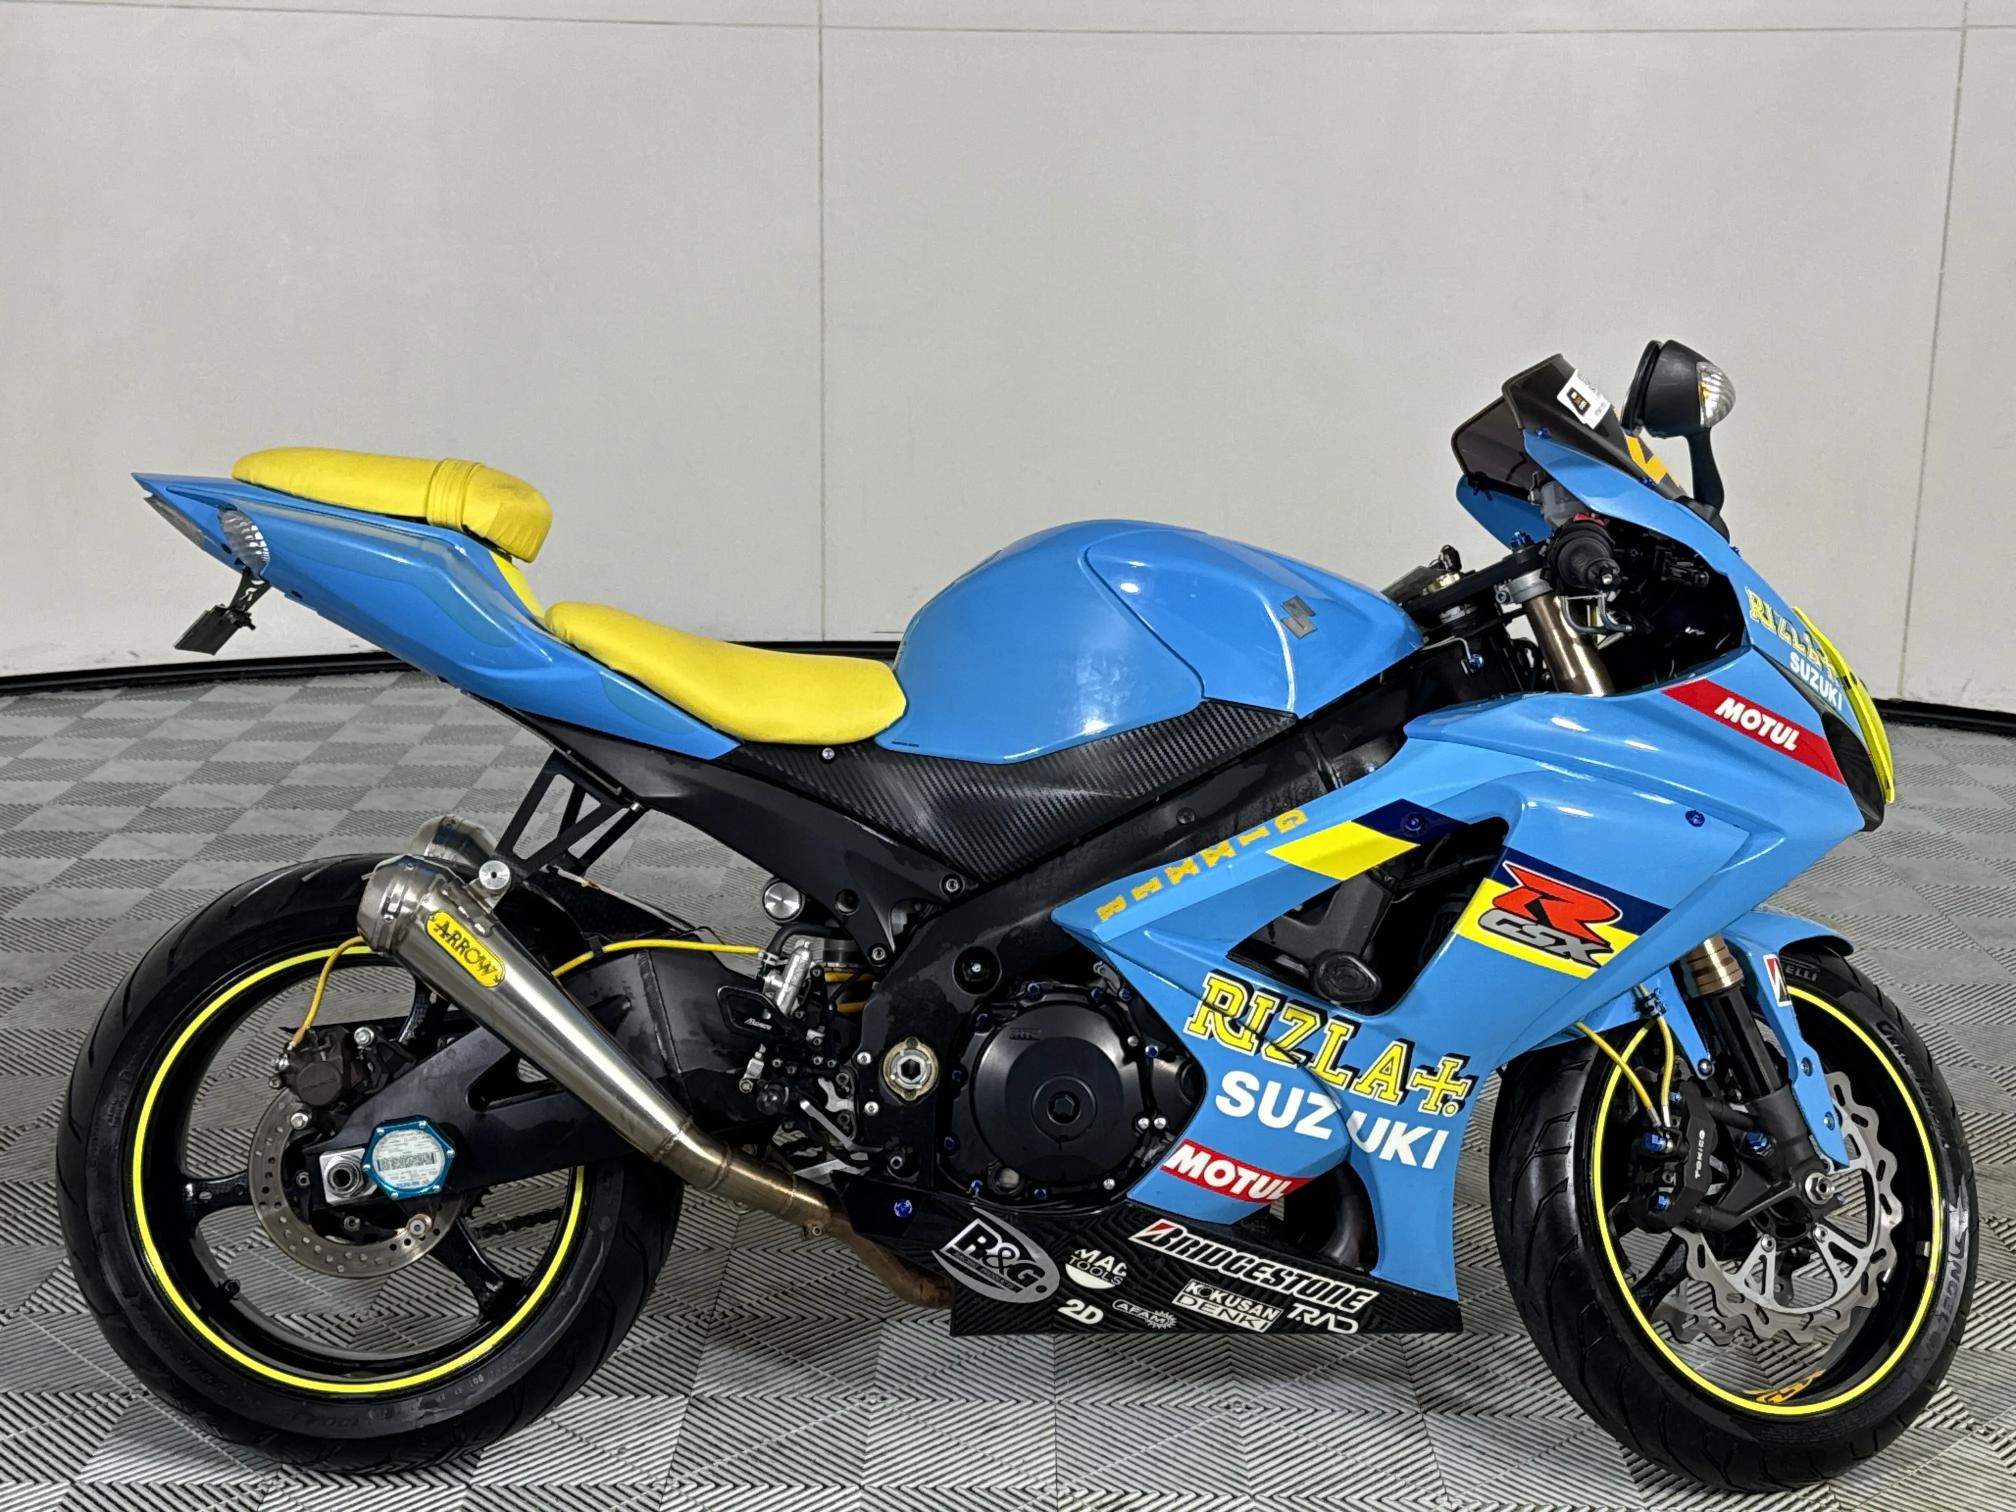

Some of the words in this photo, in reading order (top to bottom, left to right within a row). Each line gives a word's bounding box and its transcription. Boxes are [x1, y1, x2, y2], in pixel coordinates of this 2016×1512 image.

[1789, 651, 1843, 711] SUZUKI
[1714, 697, 1801, 752] MOTUL
[433, 920, 497, 977] ARROW
[1478, 907, 1615, 968] GSX
[1785, 963, 1819, 982] ELLI
[1215, 1071, 1449, 1169] SUZUKI
[1164, 1144, 1292, 1200] MOTUL
[1694, 1129, 1706, 1179] TOKICO
[944, 1220, 1046, 1288] R&G
[1069, 1255, 1124, 1286] TOOLS
[1074, 1248, 1128, 1277] MAC
[1148, 1220, 1379, 1313] BRIDGESTONE
[1057, 1299, 1104, 1325] 2D
[1116, 1302, 1168, 1325] AFAM
[1177, 1294, 1271, 1331] DENKI
[1184, 1281, 1282, 1321] KOKUSAN
